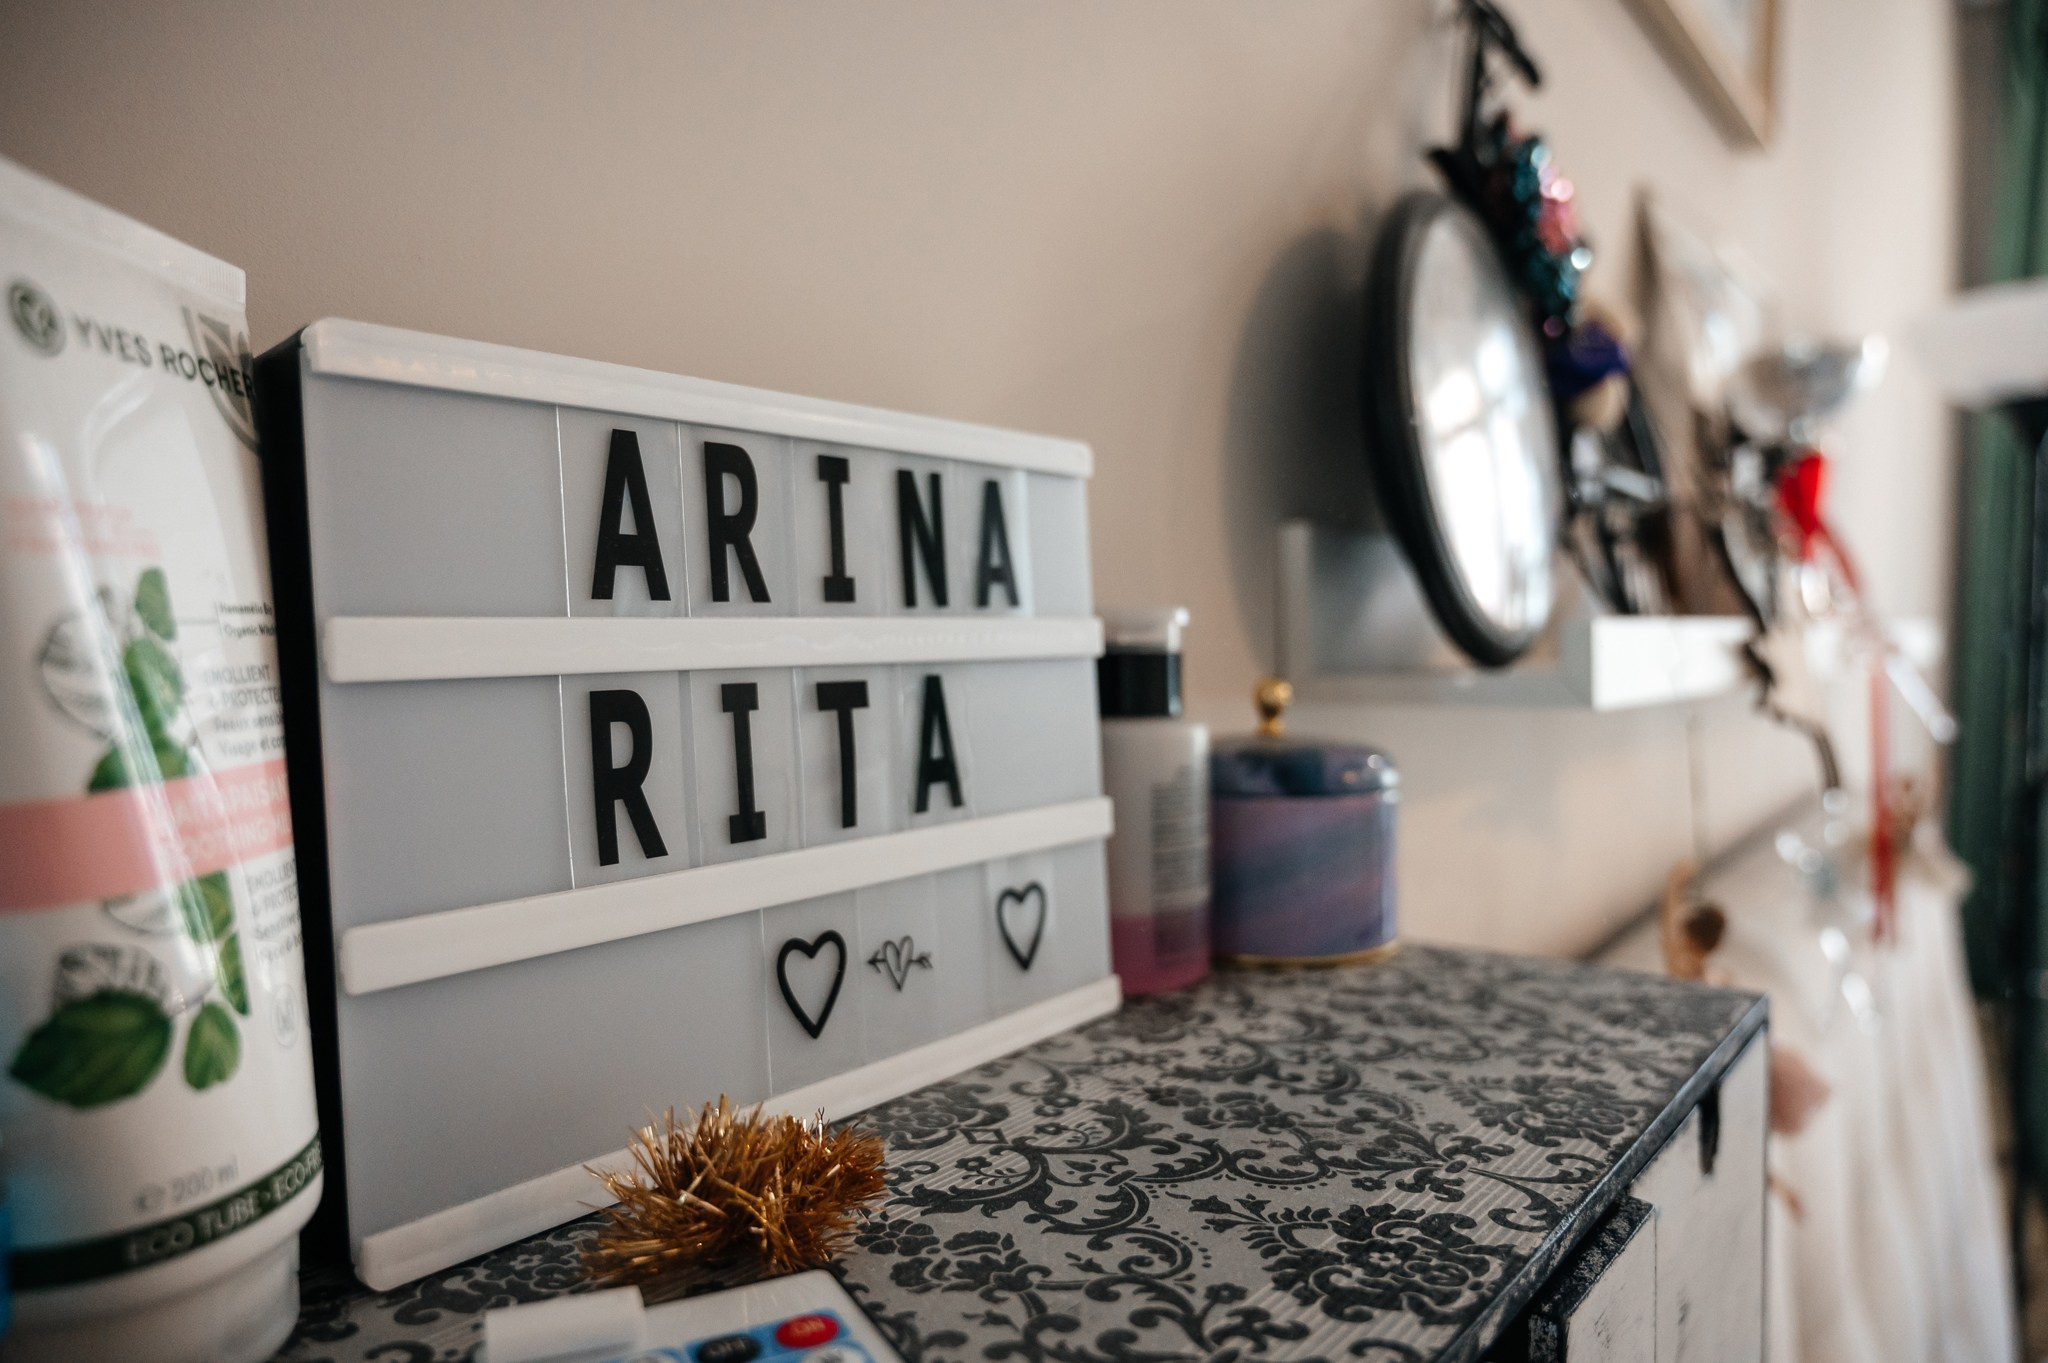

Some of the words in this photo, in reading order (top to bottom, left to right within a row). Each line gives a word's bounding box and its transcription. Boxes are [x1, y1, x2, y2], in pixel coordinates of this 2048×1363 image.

[75, 313, 152, 368] YVES
[590, 428, 1019, 608] ARINA
[588, 674, 965, 867] RITA
[197, 1190, 261, 1241] TUBE
